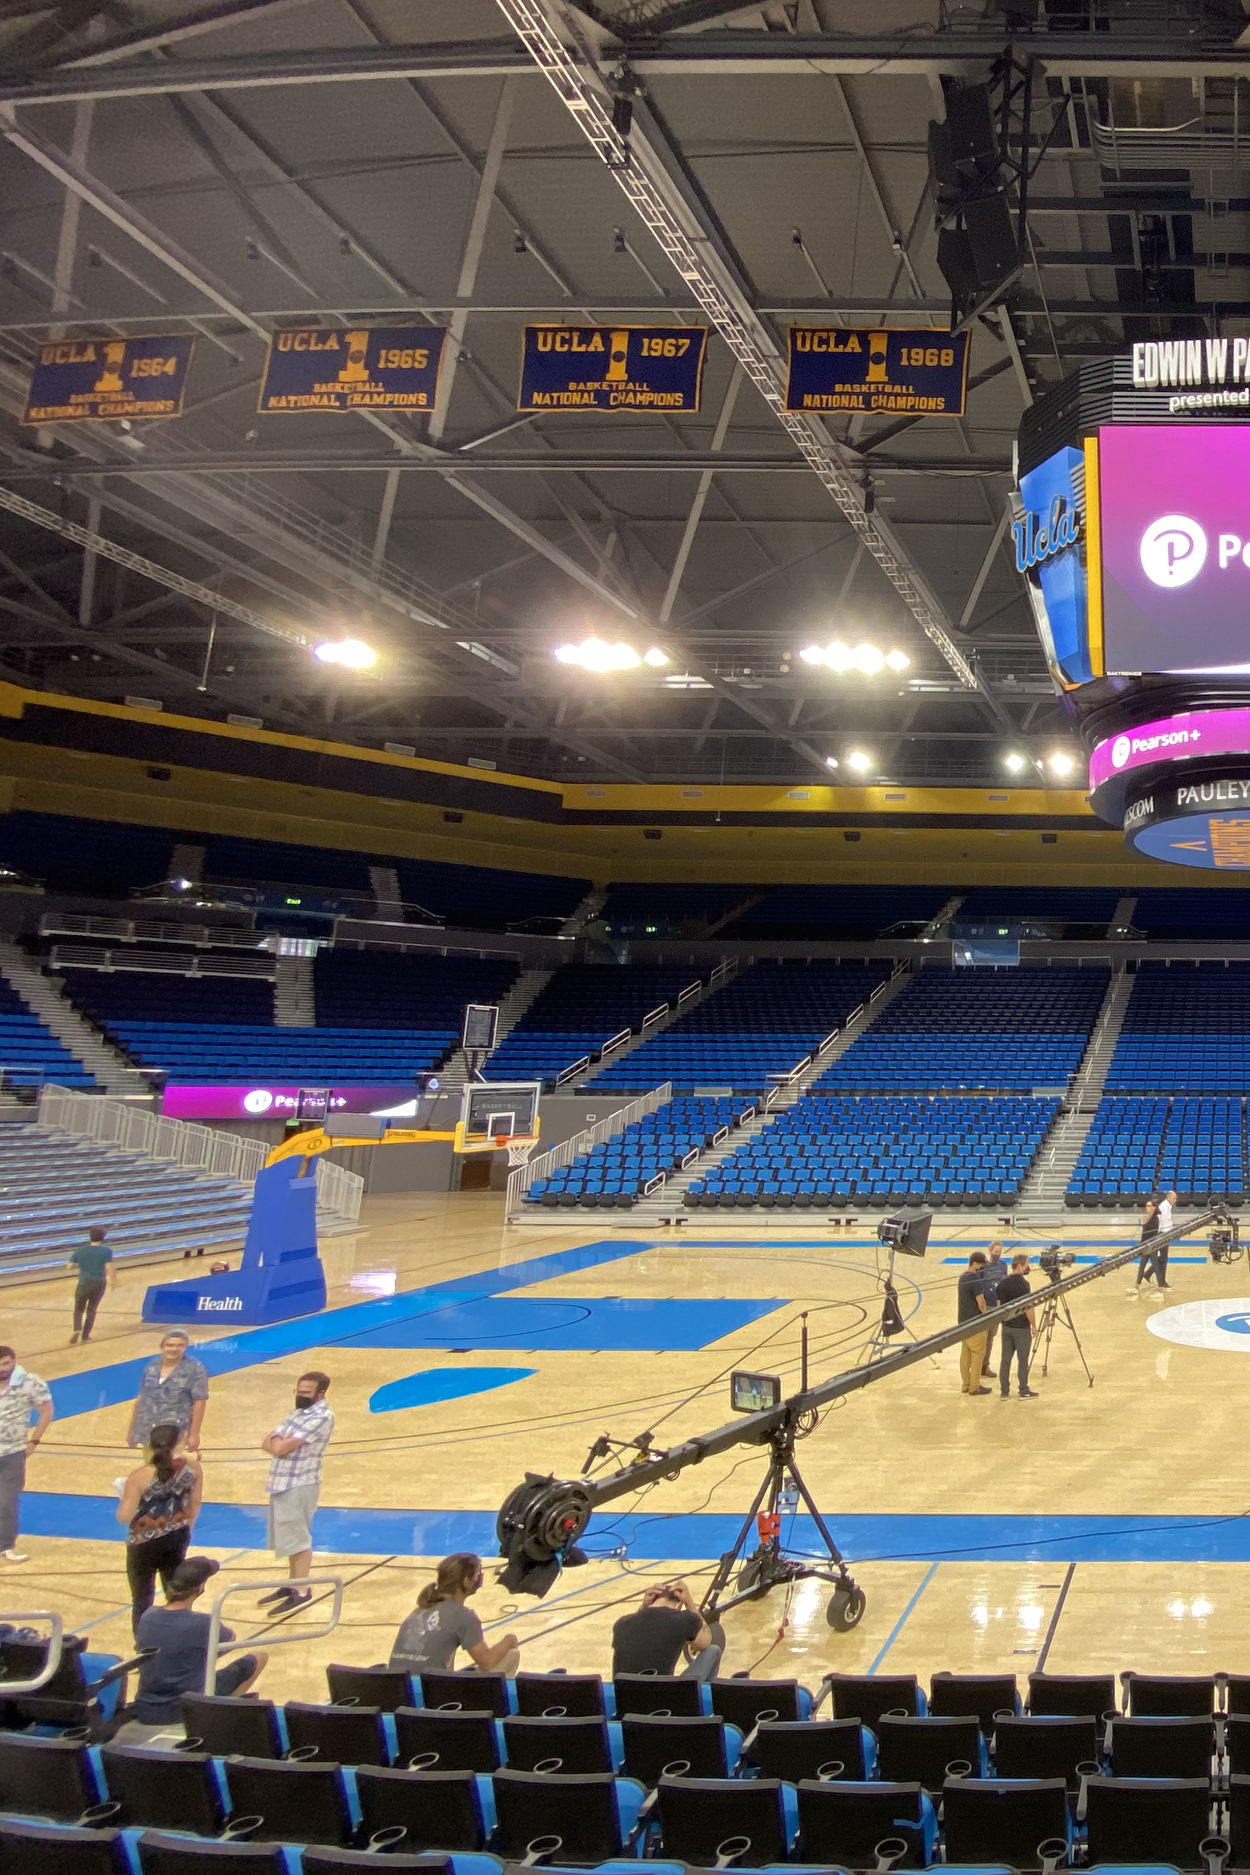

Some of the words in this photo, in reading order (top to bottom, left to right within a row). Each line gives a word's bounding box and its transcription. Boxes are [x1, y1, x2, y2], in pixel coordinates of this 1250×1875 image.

[275, 331, 340, 352] UCLA
[377, 350, 429, 369] 1965
[537, 332, 605, 352] UCLA
[641, 338, 691, 357] 1967
[796, 332, 862, 353] UCLA
[900, 348, 954, 366] 1968
[41, 346, 96, 365] UCLA
[130, 358, 177, 377] 1964
[1132, 340, 1201, 388] EDWIN
[1205, 339, 1228, 385] W
[313, 382, 385, 393] BASKETBALL
[568, 381, 650, 392] BASKETBALL
[834, 384, 916, 394] BASKETBALL
[69, 391, 134, 402] BASKETBALL
[267, 394, 340, 408] NATIONAL
[346, 393, 427, 406] CHAMPIONS
[532, 391, 598, 405] NATIONAL
[609, 392, 684, 406] CHAMPIONS
[803, 395, 865, 409] NATIONAL
[870, 396, 945, 410] CHAMPIONS
[1169, 388, 1250, 413] presented
[29, 403, 90, 419] NATIONAL
[98, 400, 175, 416] CHAMPIONS
[1132, 729, 1201, 754] Pearson+
[1177, 781, 1250, 806] PAULEY
[197, 1296, 243, 1311] Health
